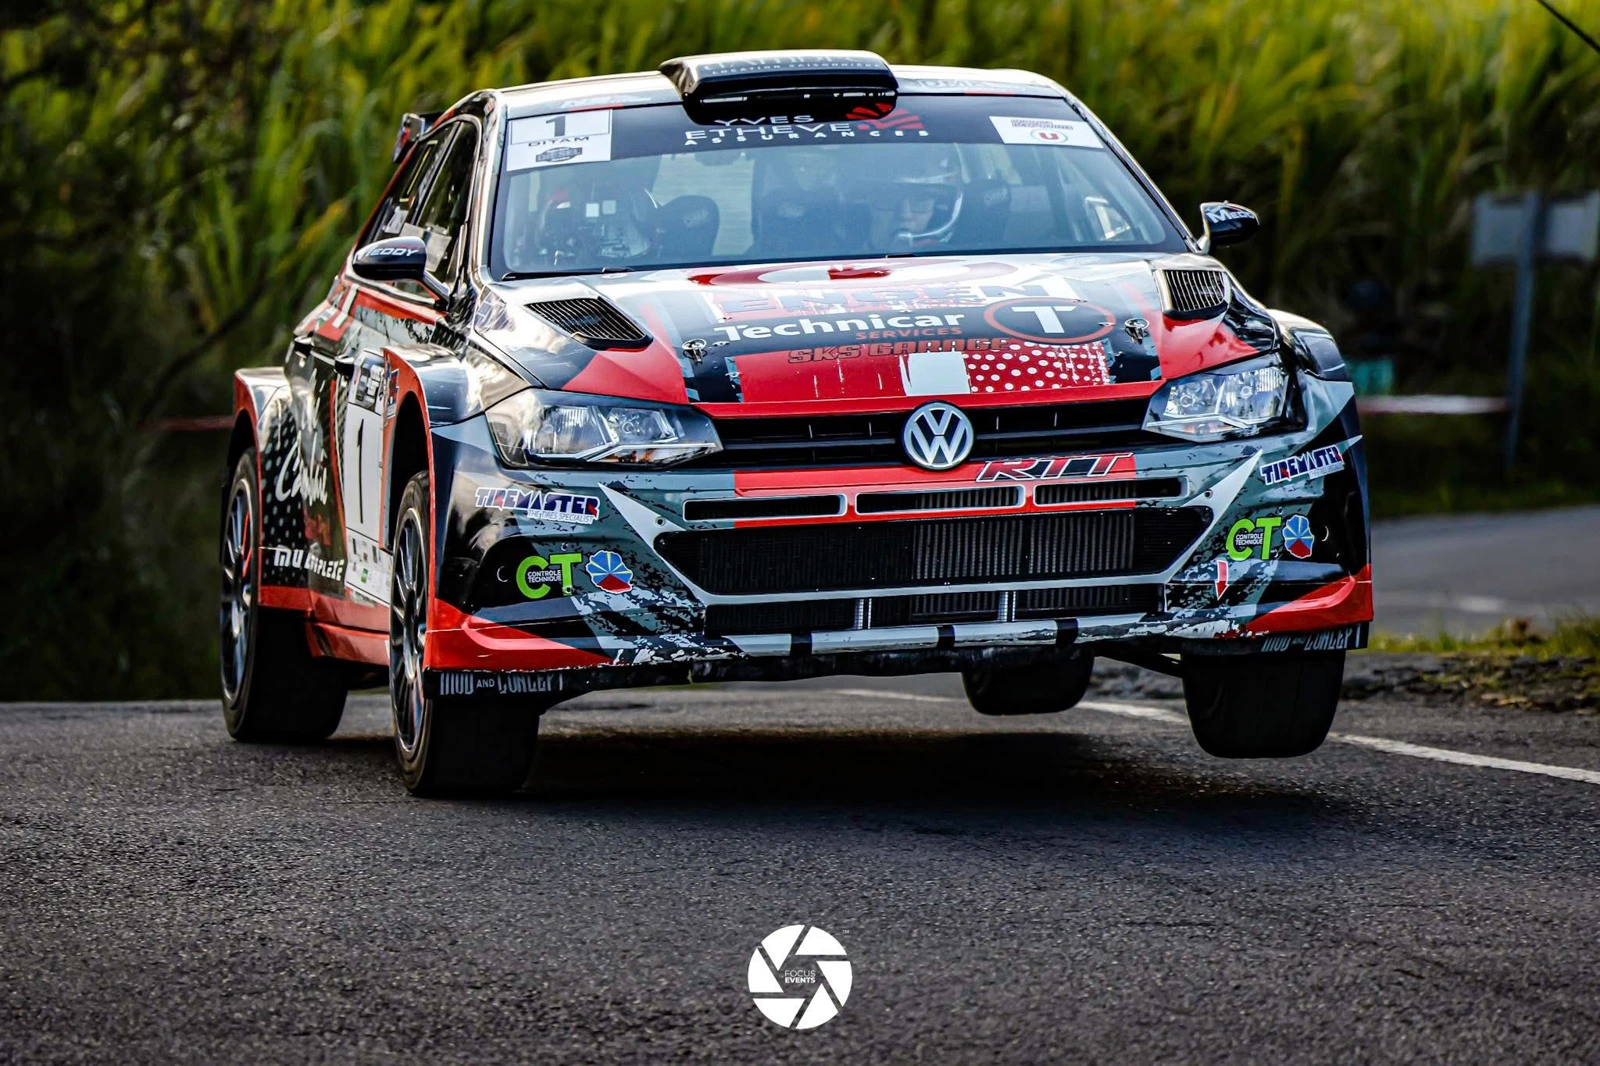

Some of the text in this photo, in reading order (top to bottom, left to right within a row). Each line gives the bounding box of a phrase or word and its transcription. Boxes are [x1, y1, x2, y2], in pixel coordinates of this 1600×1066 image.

[545, 115, 566, 138] 1
[685, 123, 852, 140] ETHEVE
[714, 115, 815, 127] YVES
[684, 129, 929, 146] ASSURANCES
[714, 313, 965, 342] Technicar
[1011, 305, 1077, 334] T
[855, 327, 964, 342] SERVICES
[787, 337, 1014, 365] SKS GARAGE
[357, 418, 369, 525] 1
[1261, 446, 1343, 483] TIREMASTER
[475, 487, 600, 519] TIREMASTER
[1225, 516, 1282, 562] CT
[516, 553, 582, 599] CT
[476, 678, 496, 689] AND
